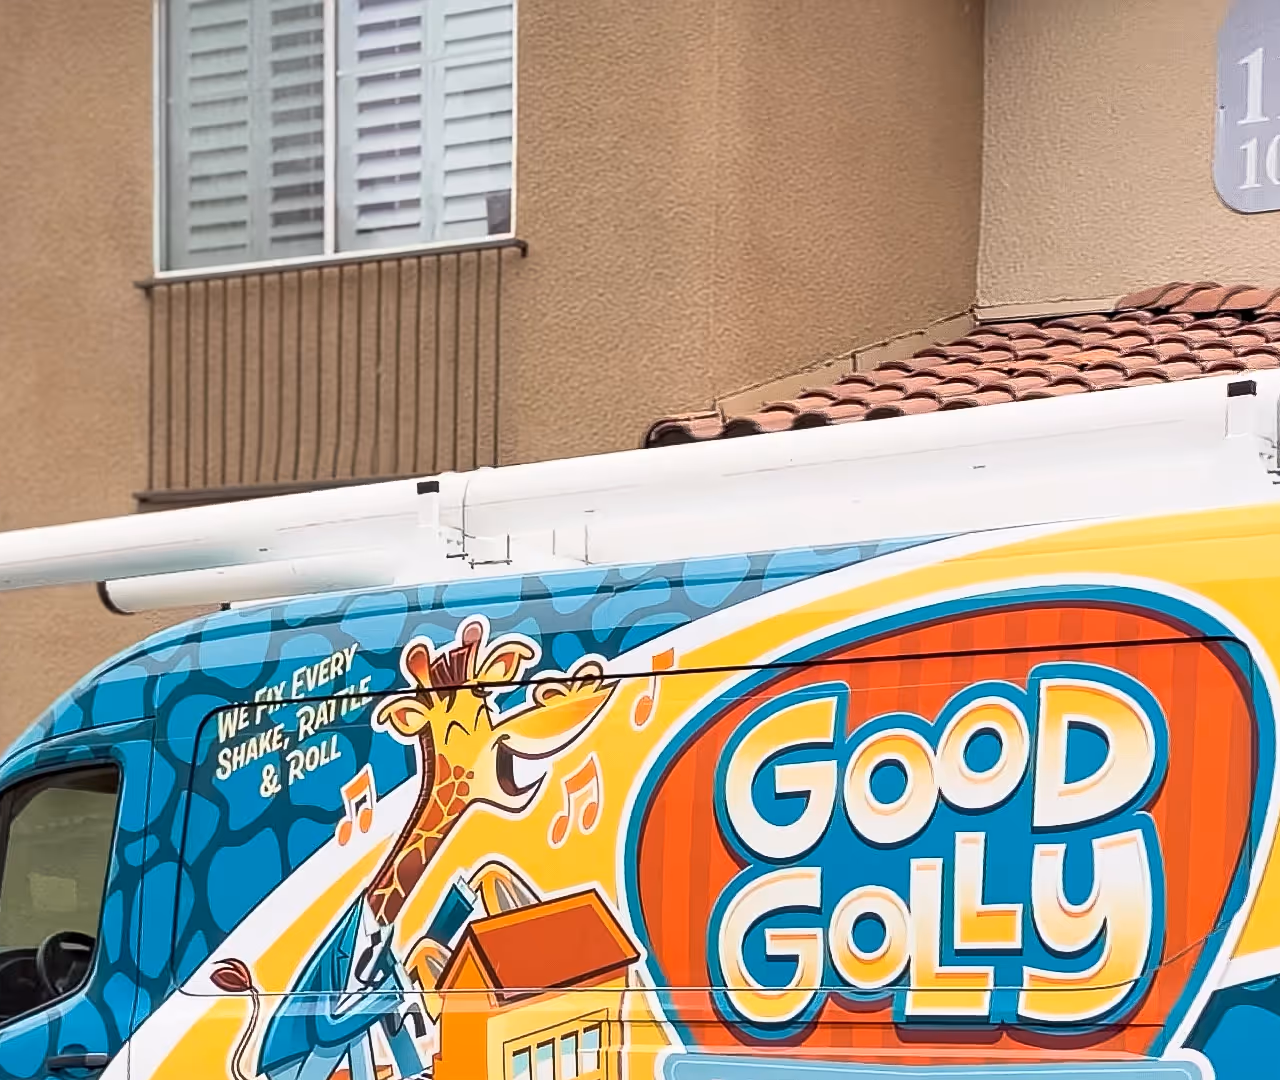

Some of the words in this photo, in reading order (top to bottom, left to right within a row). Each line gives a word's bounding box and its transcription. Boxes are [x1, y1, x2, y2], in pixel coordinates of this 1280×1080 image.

[216, 723, 290, 781] SHAKE,
[296, 675, 373, 741] RATTLE
[218, 701, 250, 743] WE
[254, 680, 287, 725] FIX
[291, 642, 360, 704] EVERY
[259, 764, 282, 798] &
[285, 734, 342, 786] ROLL
[724, 677, 1157, 860] GOOD
